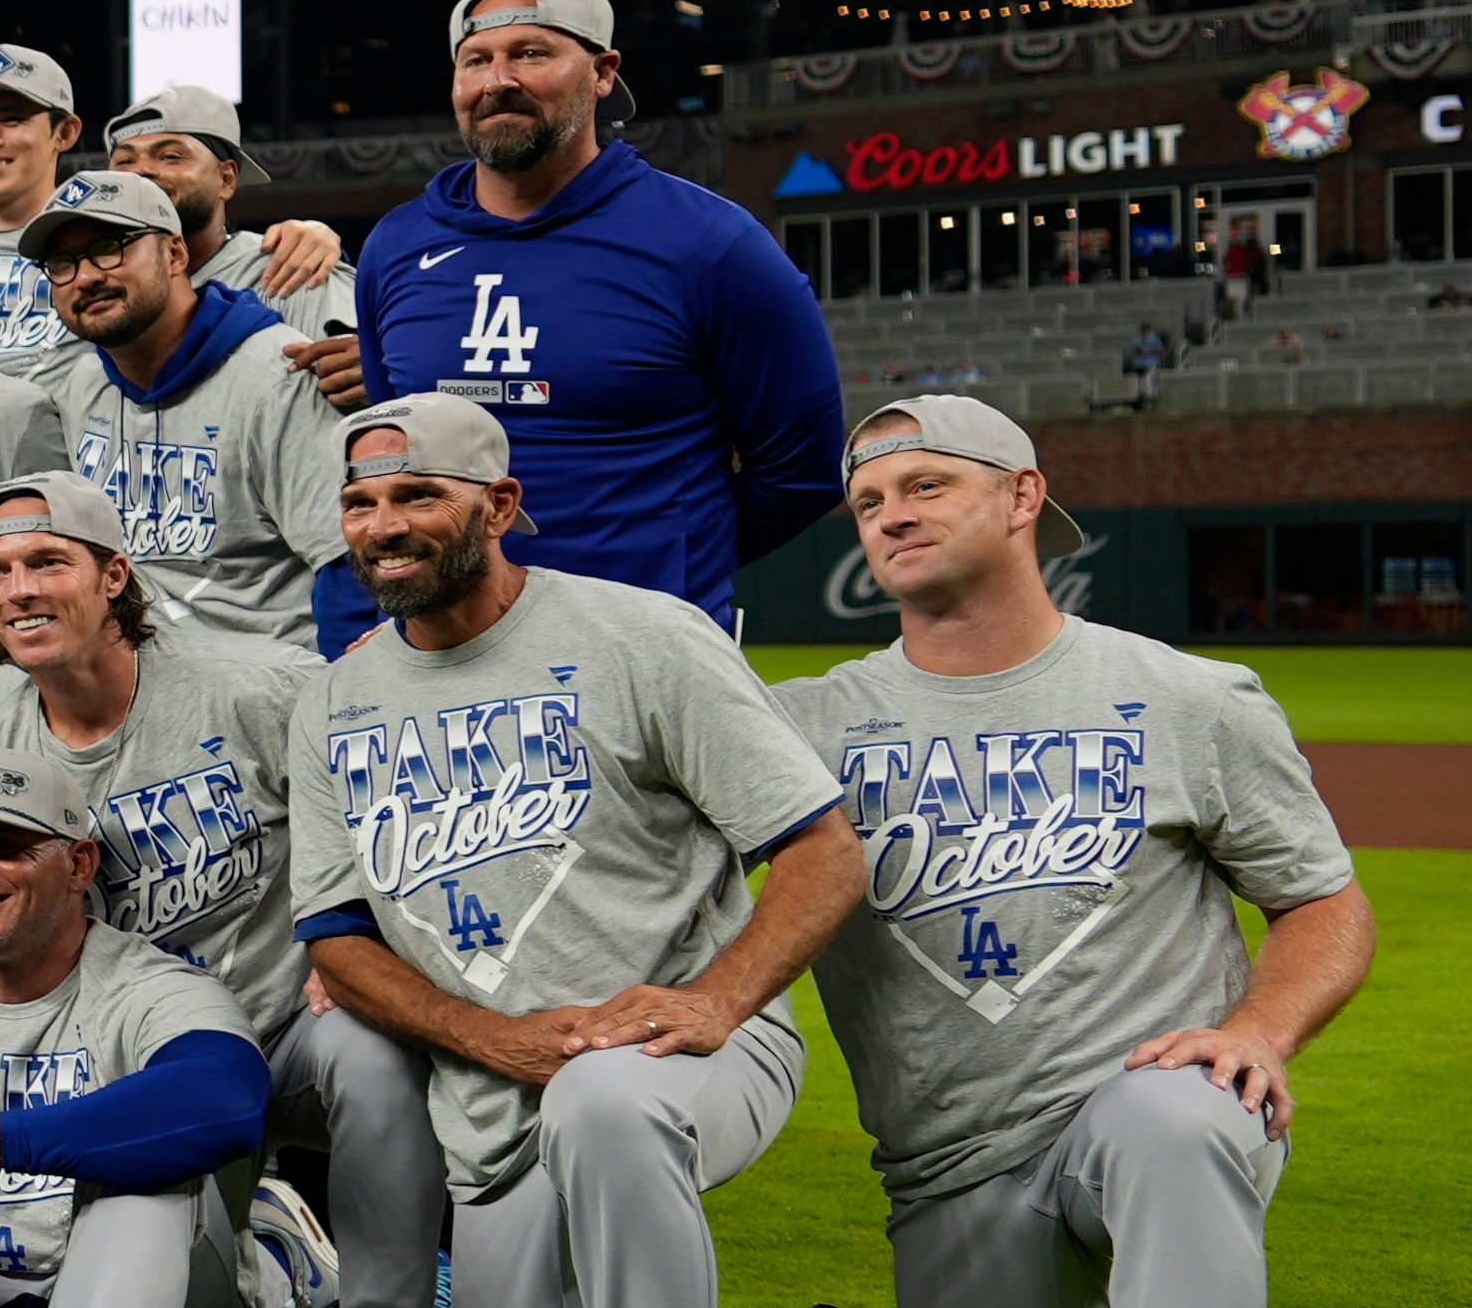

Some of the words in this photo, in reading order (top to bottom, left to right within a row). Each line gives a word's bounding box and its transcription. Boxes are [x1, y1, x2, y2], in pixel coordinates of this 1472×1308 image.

[141, 0, 230, 33] CHIKIN
[63, 180, 89, 205] LA
[845, 131, 1012, 192] Coors
[1017, 123, 1182, 179] LIGHT
[460, 274, 539, 373] LA
[328, 692, 592, 827] TAKE
[840, 729, 1146, 839] TAKE
[85, 760, 263, 885] AKE
[357, 763, 590, 897] October
[861, 793, 1141, 912] October
[440, 880, 505, 952] LA
[958, 907, 1018, 980] LA
